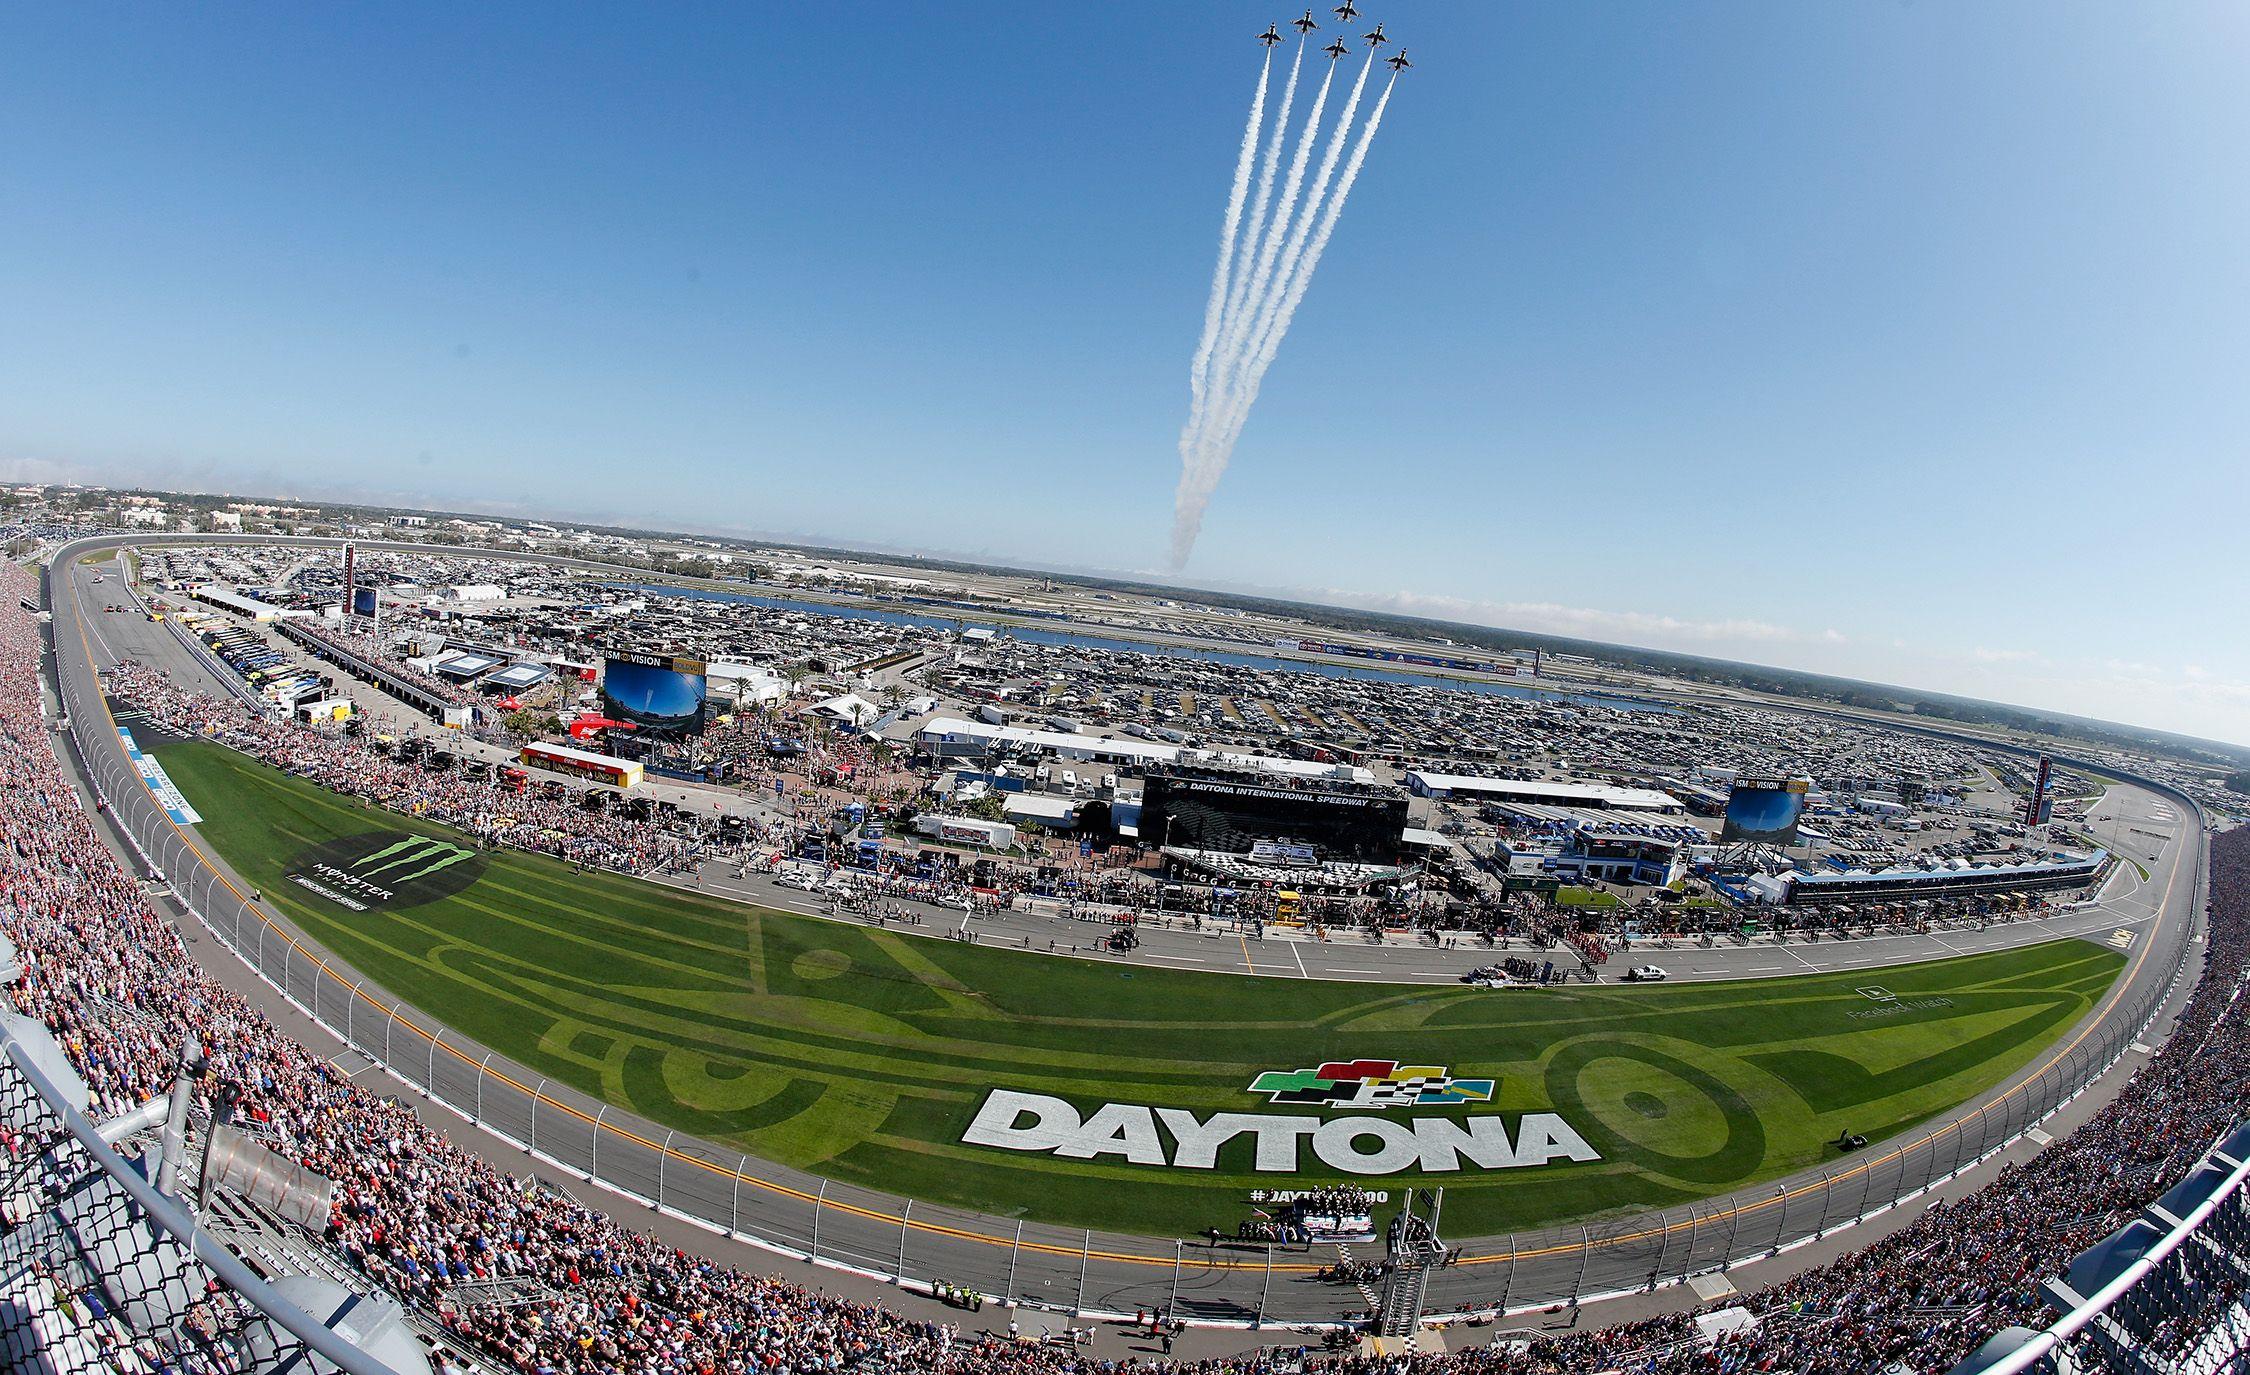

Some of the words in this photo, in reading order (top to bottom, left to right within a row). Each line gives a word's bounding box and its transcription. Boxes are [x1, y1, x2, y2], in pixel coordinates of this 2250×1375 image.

[605, 650, 620, 661] ISM
[630, 654, 661, 667] VISION
[1189, 782, 1235, 794] DAYTONA
[1235, 787, 1315, 803] INTERNATIONAL
[1316, 795, 1369, 808] SPEEDWAY
[1735, 779, 1749, 788] ISM
[1756, 781, 1780, 790] VISION
[313, 872, 371, 898] ENERGY
[961, 1088, 1602, 1175] DAYTONA
